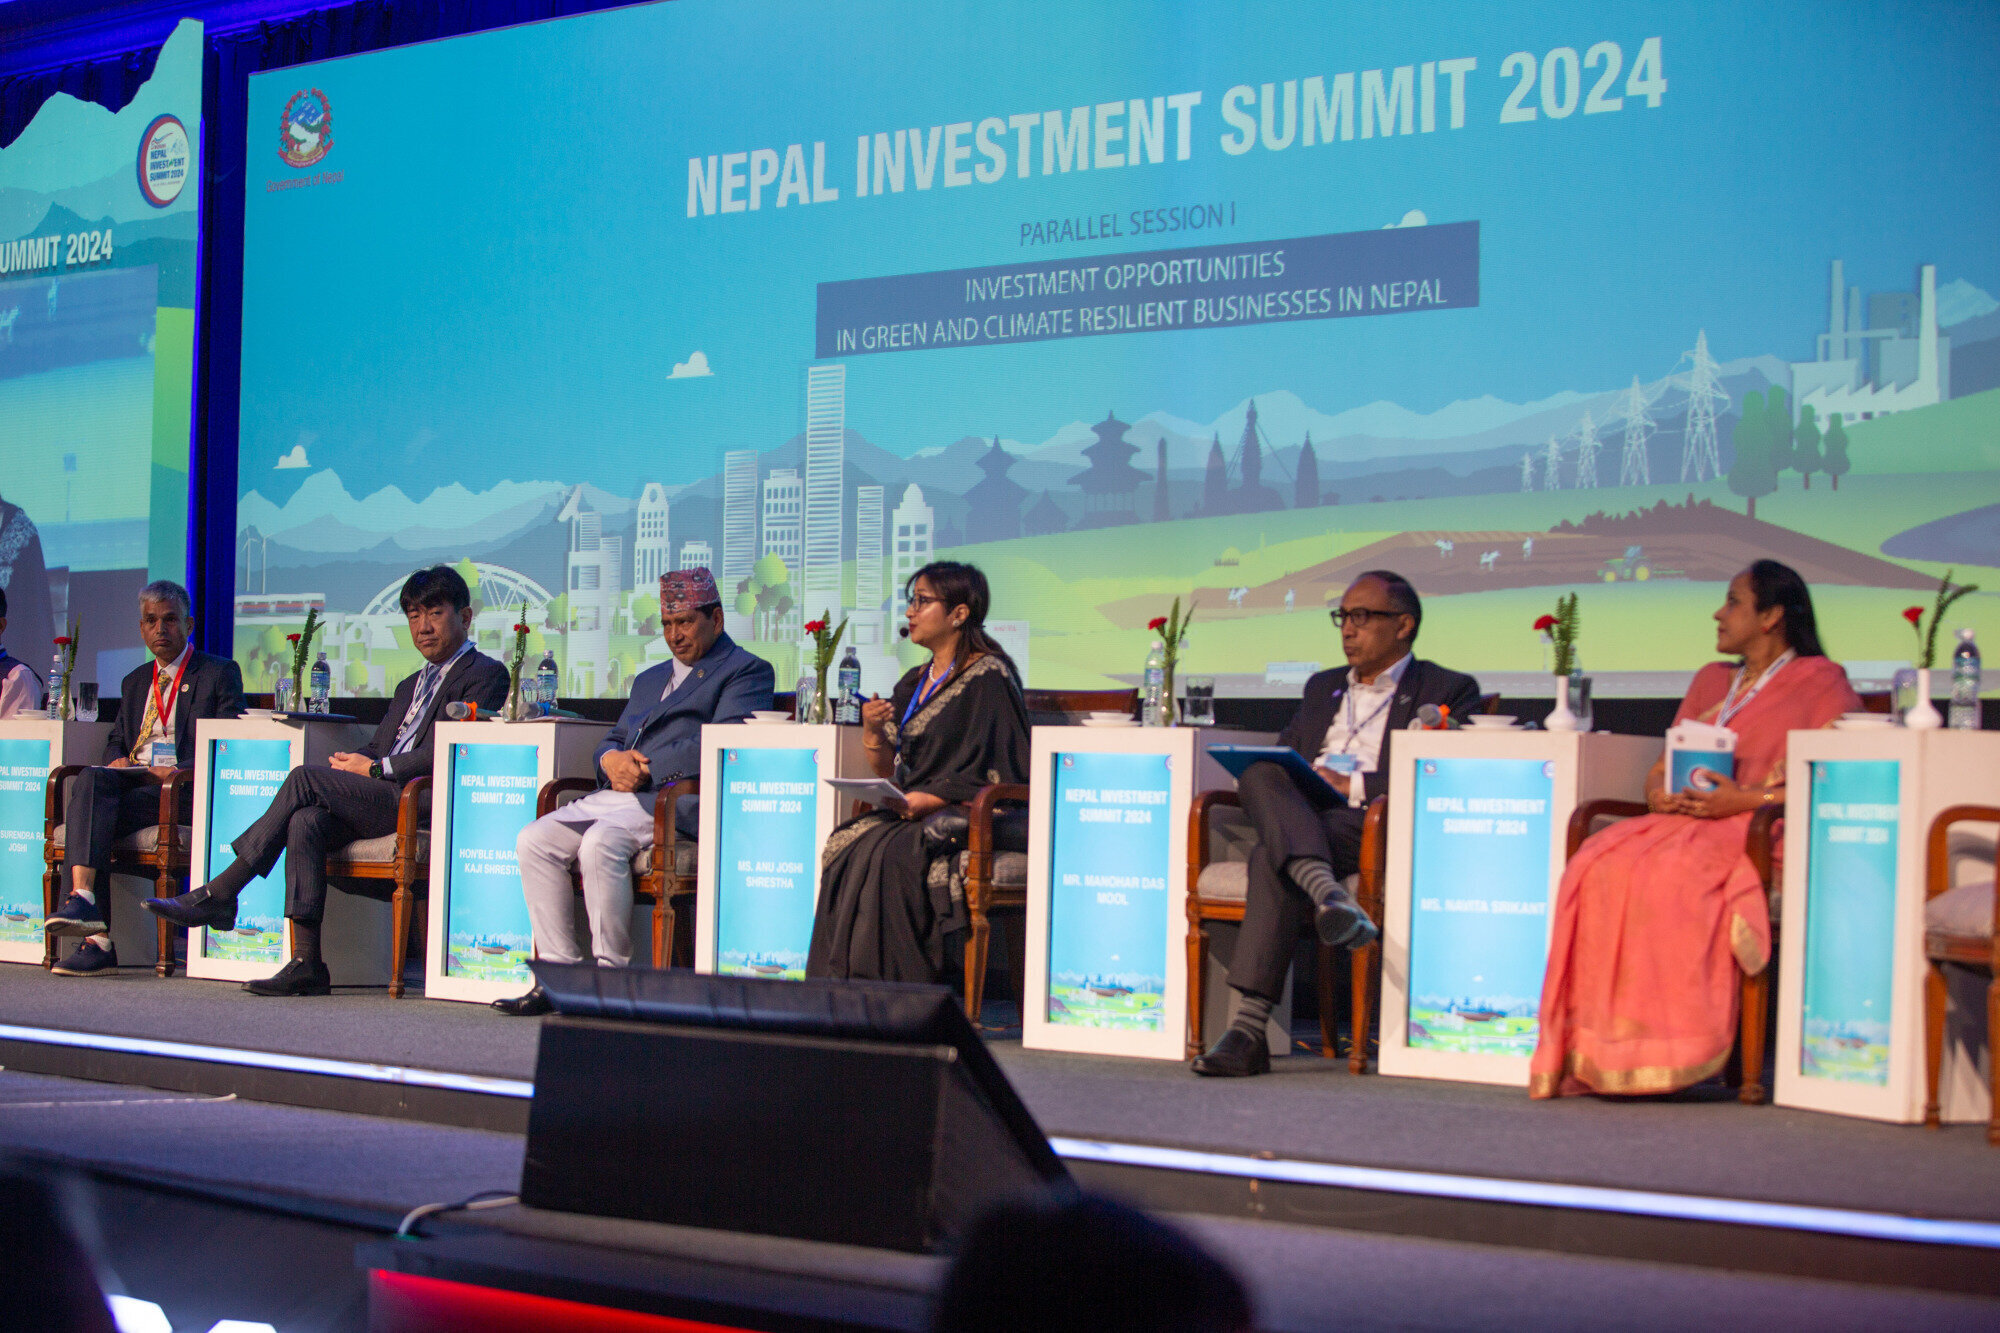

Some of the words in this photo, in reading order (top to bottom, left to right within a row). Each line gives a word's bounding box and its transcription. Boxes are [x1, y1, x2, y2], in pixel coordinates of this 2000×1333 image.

[687, 142, 839, 218] NEPAL
[856, 91, 1202, 197] INVESTMENT
[1220, 57, 1477, 156] SUMMIT
[1499, 37, 1667, 124] 2024
[265, 175, 311, 193] Government
[312, 172, 321, 187] of
[322, 168, 344, 185] Nepal
[1019, 213, 1123, 247] PARALLEL
[1129, 202, 1223, 236] SESSION
[0, 234, 61, 274] UMMIT
[66, 228, 113, 265] 2024
[965, 266, 1099, 303] INVESTMENT
[1104, 251, 1286, 291] OPPORTUNITIES
[837, 328, 856, 351] IN
[862, 321, 928, 350] GREEN
[933, 317, 979, 344] AND
[984, 309, 1073, 340] CLIMATE
[1079, 300, 1188, 333] RESILIENT
[1193, 287, 1331, 324] BUSINESSES
[1338, 286, 1364, 312] IN
[1371, 278, 1447, 309] NEPAL
[220, 769, 243, 780] NEPAL
[461, 774, 486, 787] NEPAL
[487, 775, 538, 789] INVESTMENT
[25, 781, 41, 792] 2024
[229, 784, 259, 796] SUMMIT
[730, 781, 758, 795] NEPAL
[759, 781, 815, 796] INVESTMENT
[471, 791, 503, 804] SUMMIT
[505, 792, 525, 805] 2024
[1065, 788, 1099, 803] NEPAL
[742, 799, 777, 813] SUMMIT
[779, 800, 802, 814] 2024
[1, 830, 35, 840] SURENDRA
[36, 831, 45, 841] RA
[8, 842, 28, 852] JOSHI
[459, 848, 494, 860] HON'BLE
[464, 862, 483, 873] KAJI
[484, 863, 521, 876] SHRESTH
[737, 860, 753, 872] MS.
[755, 861, 775, 874] ANU
[776, 862, 803, 874] JOSHI
[745, 876, 794, 889] SHRESTHA
[1141, 876, 1165, 891] DAS
